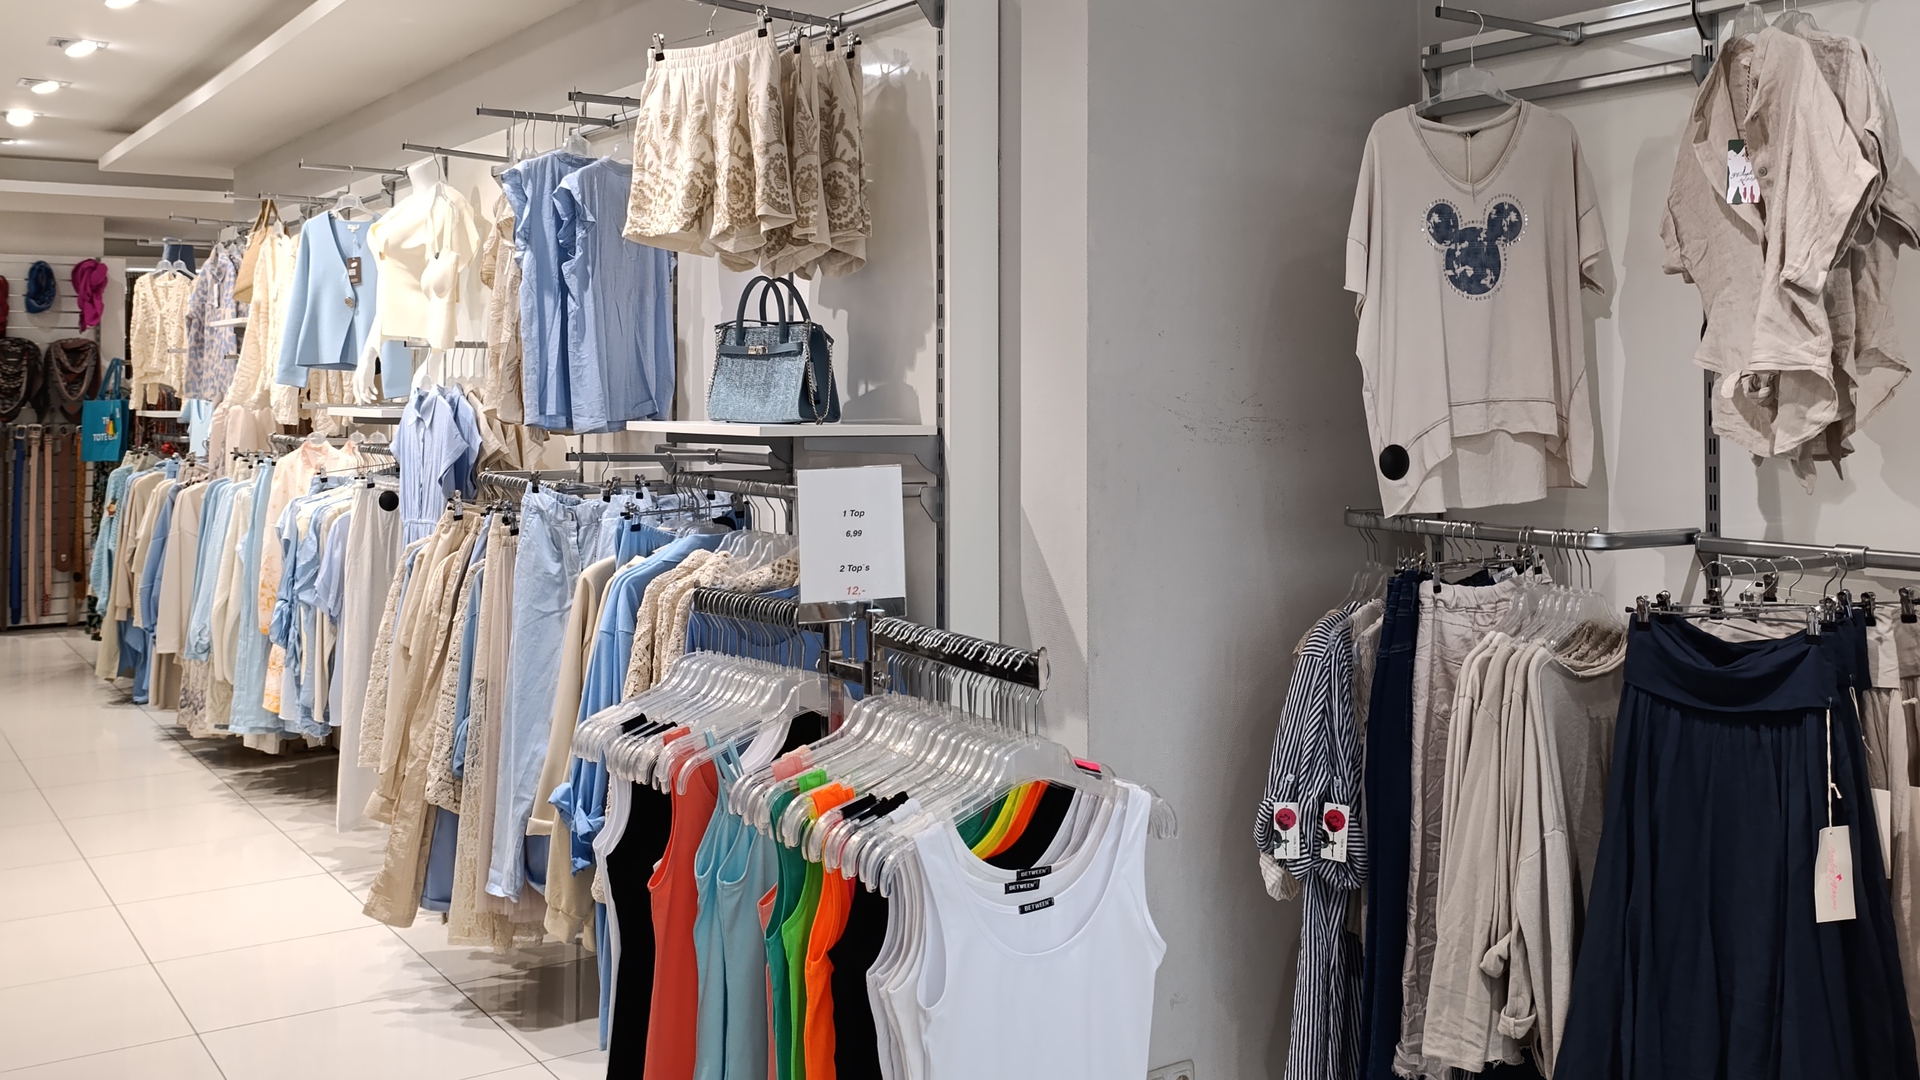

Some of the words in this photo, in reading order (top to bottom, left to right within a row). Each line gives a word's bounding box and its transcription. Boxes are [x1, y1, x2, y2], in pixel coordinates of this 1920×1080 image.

[850, 509, 865, 519] Top
[845, 529, 863, 538] 6,99
[839, 564, 845, 573] 2
[846, 585, 866, 597] 12,-
